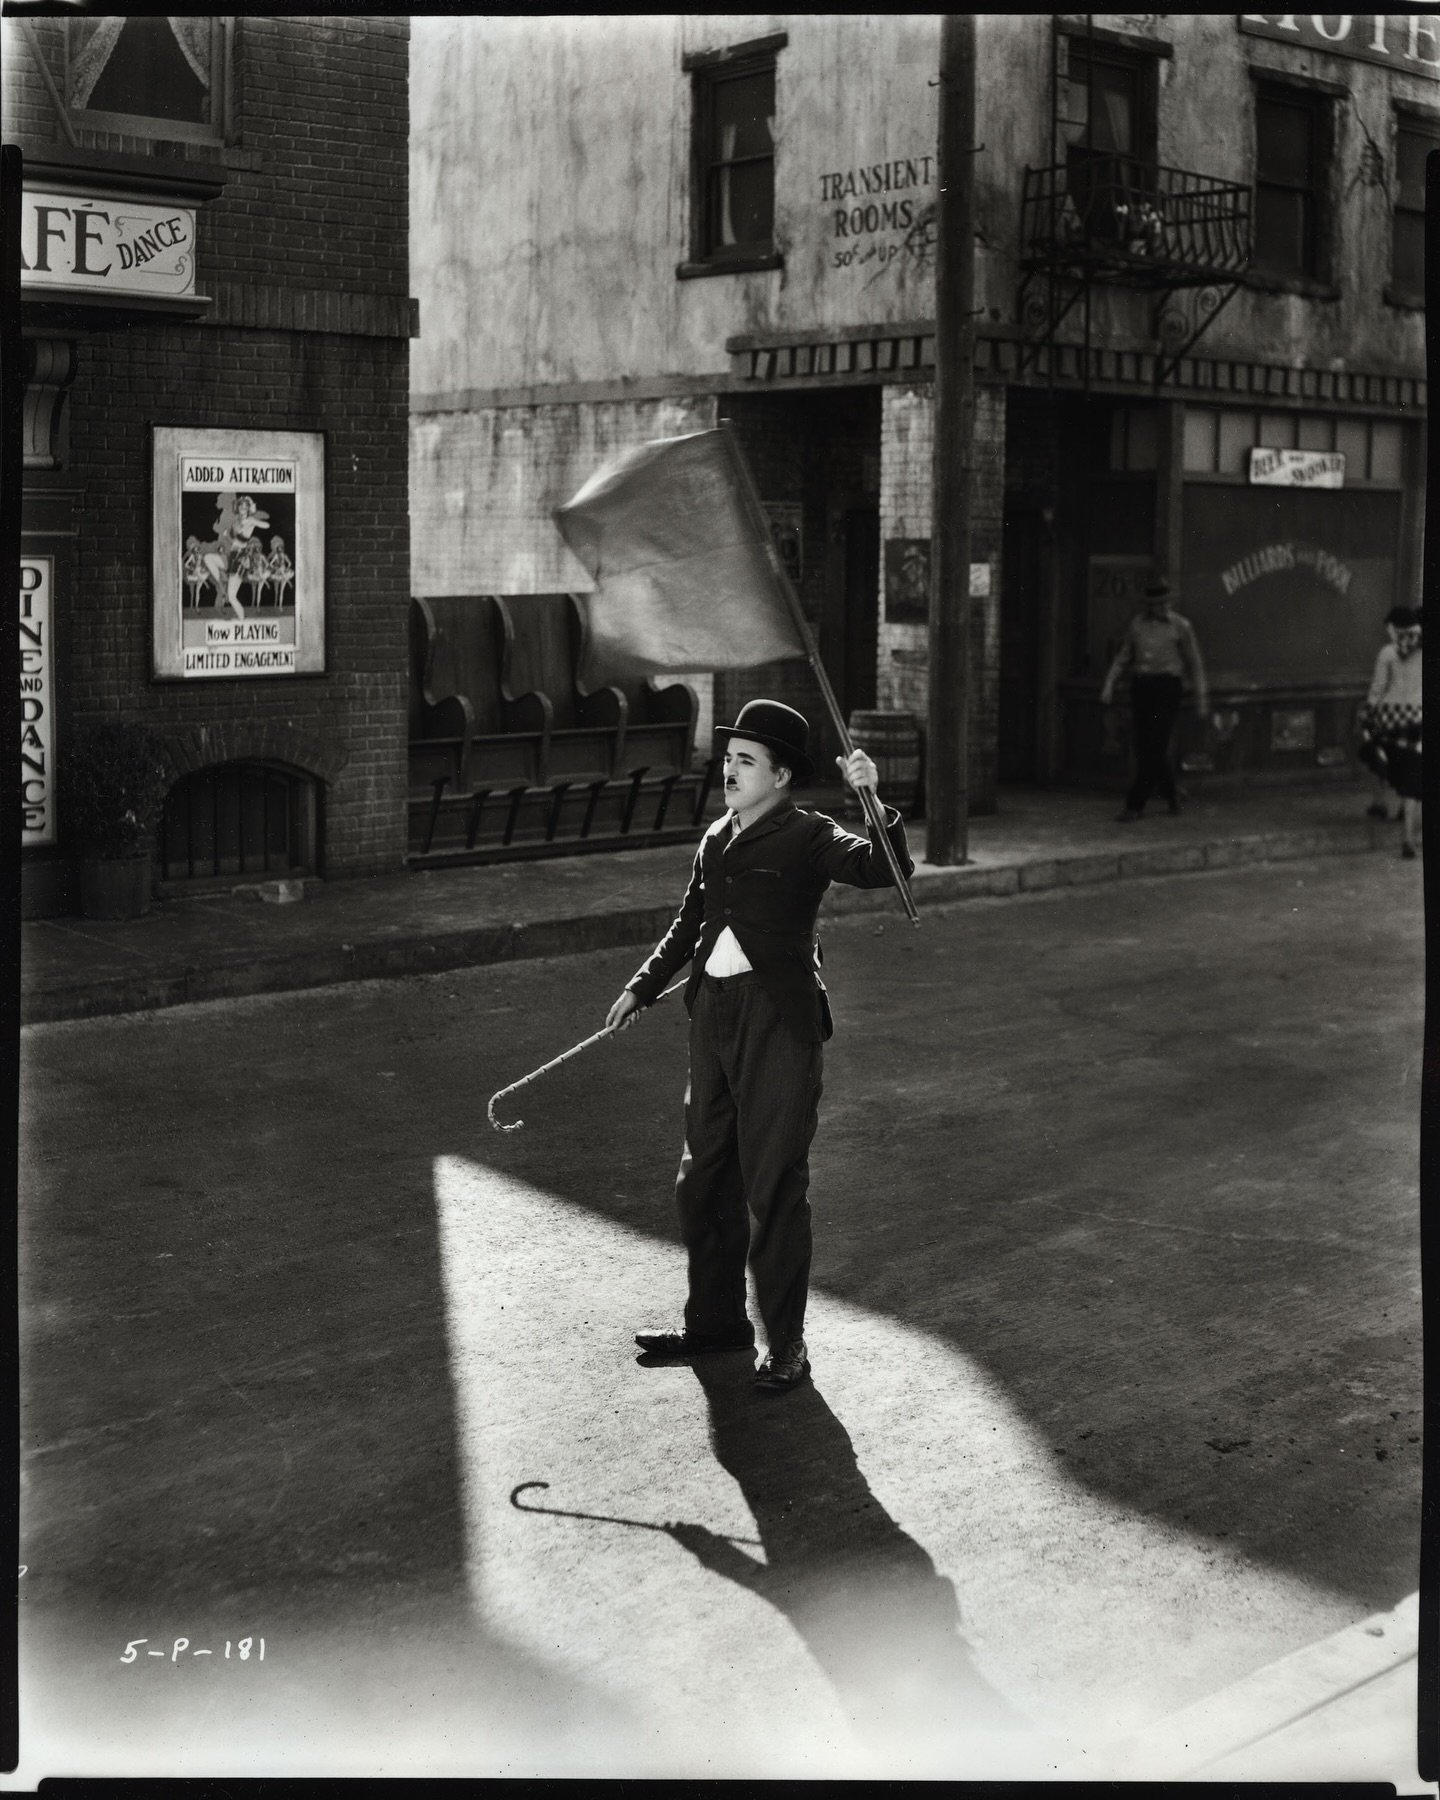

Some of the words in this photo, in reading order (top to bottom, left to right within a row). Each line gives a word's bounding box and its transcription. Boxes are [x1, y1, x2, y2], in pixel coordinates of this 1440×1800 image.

[819, 156, 934, 201] TRANSIENT
[21, 202, 112, 277] FÉ
[116, 217, 187, 270] DANCE
[834, 200, 914, 237] ROOMS
[186, 466, 224, 483] ADDED
[229, 467, 292, 484] ATTRACTION
[1222, 543, 1295, 595] BILLIARDS
[20, 566, 43, 674] DINE
[234, 624, 278, 640] PLAYING
[185, 653, 230, 670] LIMITED
[234, 651, 294, 668] ENGAGEMENT
[21, 697, 46, 831] DANCE
